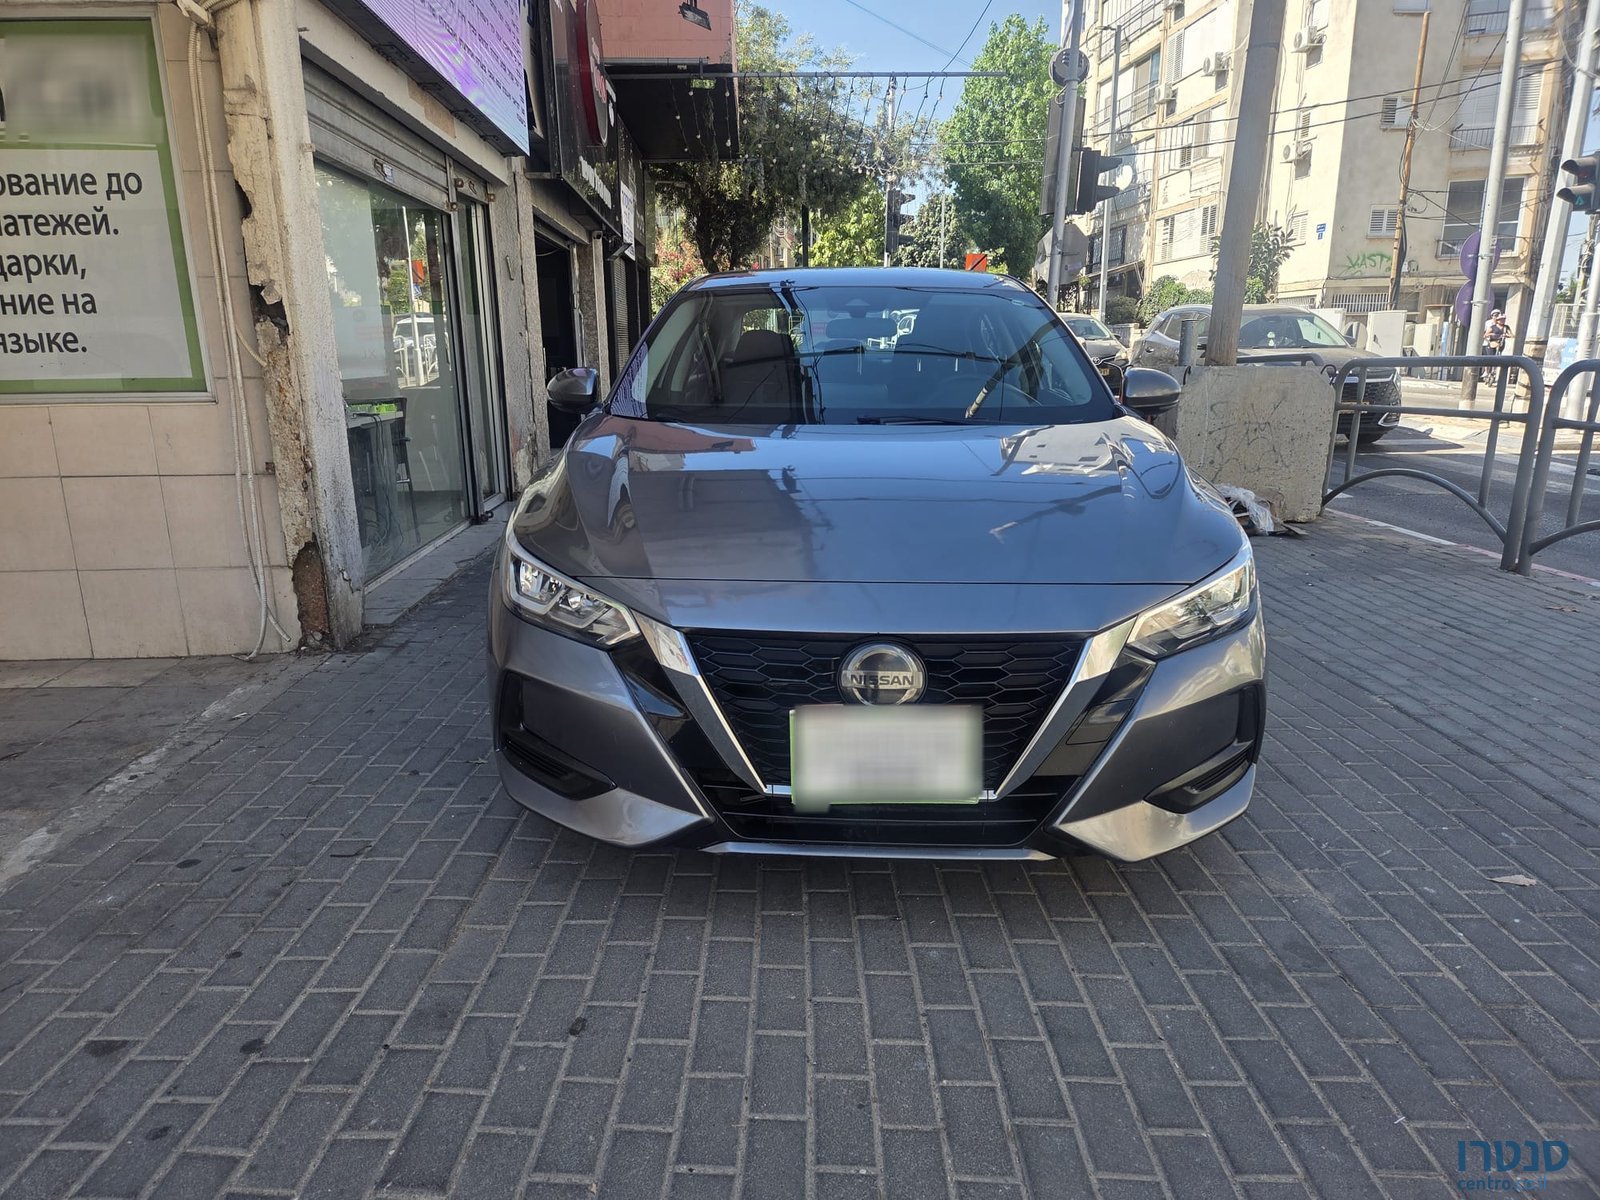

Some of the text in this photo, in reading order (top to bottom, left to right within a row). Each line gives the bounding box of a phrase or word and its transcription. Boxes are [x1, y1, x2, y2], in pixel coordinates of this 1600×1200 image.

[105, 172, 143, 201] до
[0, 205, 119, 237] атежей.
[61, 292, 98, 315] на
[850, 673, 915, 686] NISSAN
